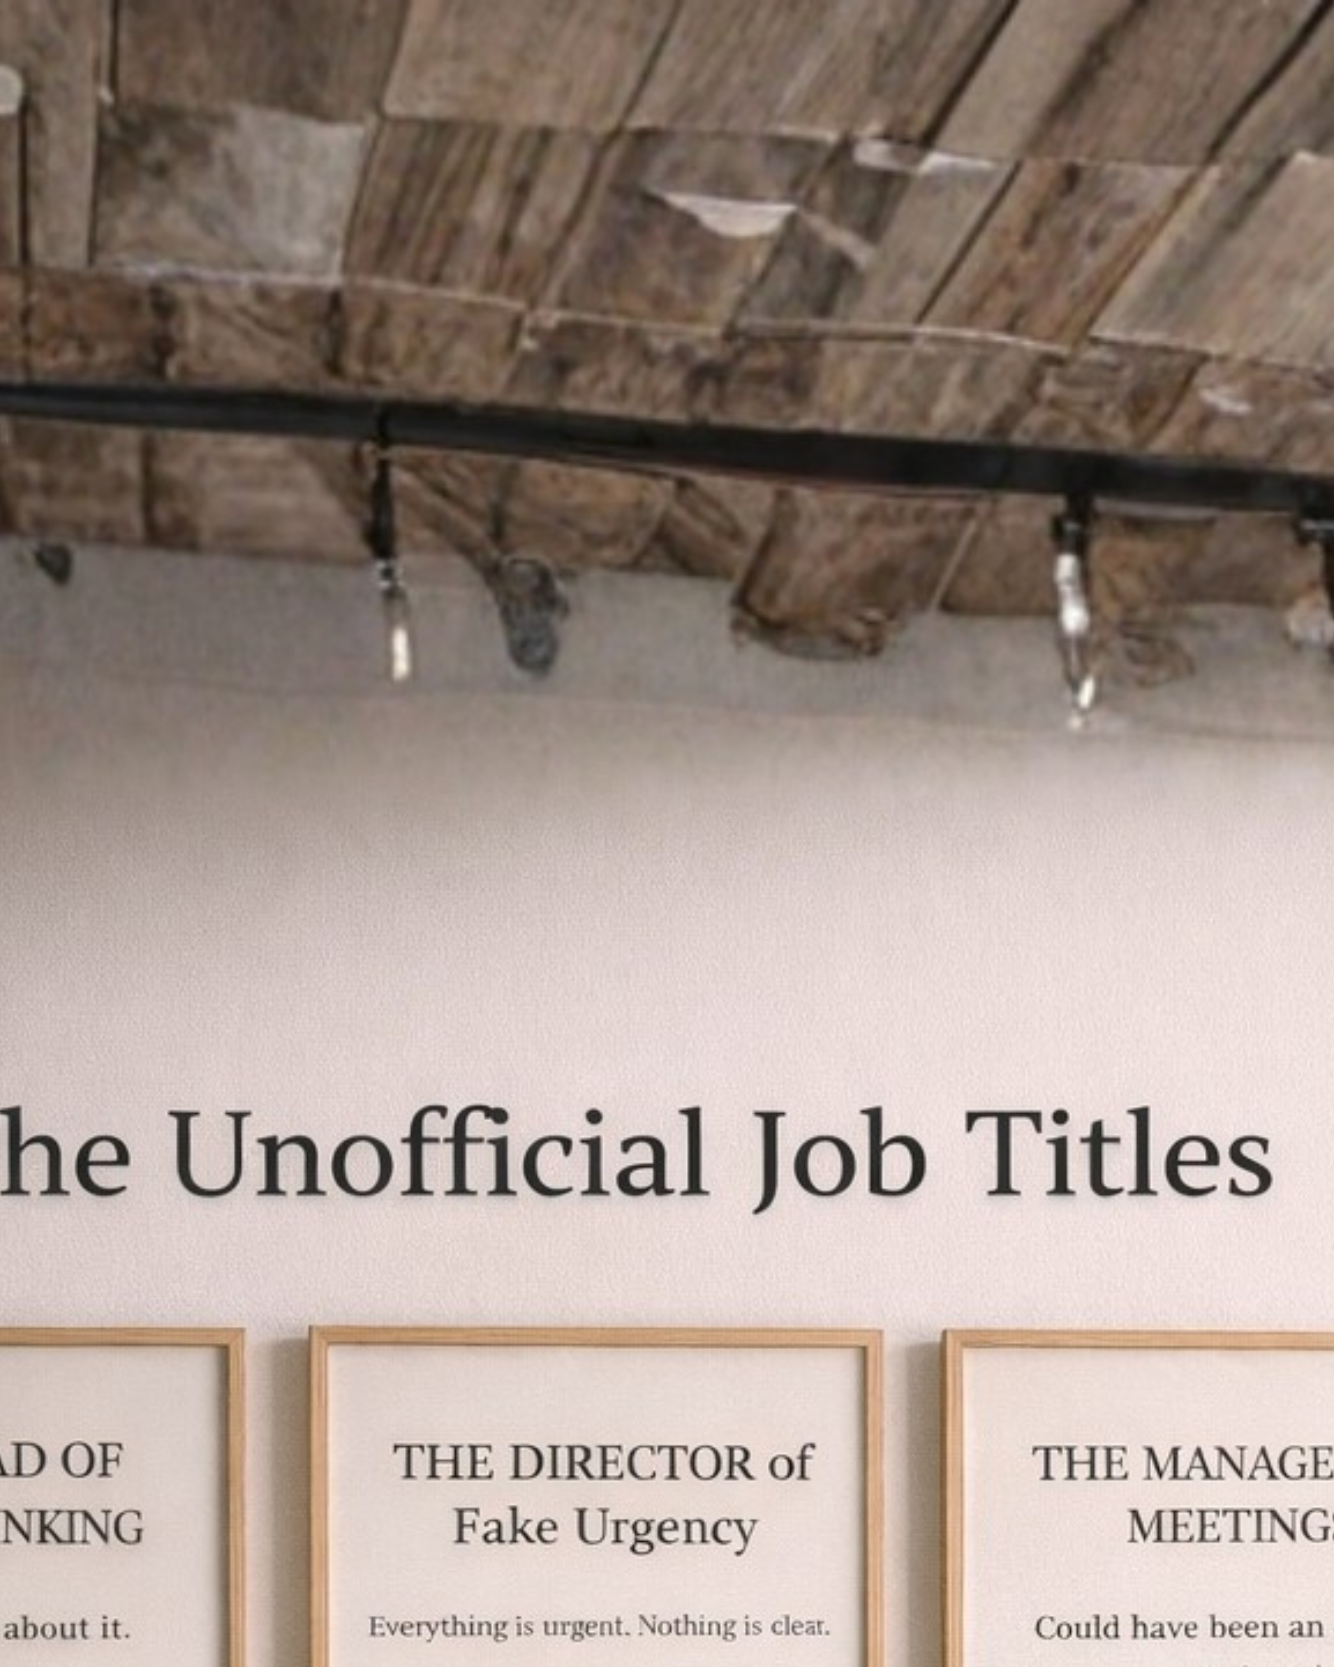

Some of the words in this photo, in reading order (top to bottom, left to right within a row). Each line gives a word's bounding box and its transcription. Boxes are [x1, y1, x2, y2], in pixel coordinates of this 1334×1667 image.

[167, 1104, 710, 1199] Unofficial
[752, 1106, 926, 1215] Job
[965, 1106, 1273, 1199] Titles
[61, 1441, 123, 1478] OF
[392, 1443, 494, 1480] THE
[509, 1443, 756, 1481] DIRECTOR
[768, 1442, 816, 1481] of
[1032, 1445, 1129, 1481] THE
[453, 1505, 558, 1545] Fake
[574, 1506, 759, 1557] Urgency
[4, 1615, 88, 1641] about
[101, 1615, 130, 1641] it.
[369, 1614, 509, 1643] Everything
[515, 1615, 534, 1637] is
[543, 1616, 631, 1643] urgent.
[639, 1614, 737, 1642] Nothing
[744, 1614, 763, 1636] is
[771, 1614, 830, 1636] clear.
[1034, 1614, 1120, 1640] Could
[1131, 1613, 1199, 1640] have
[1209, 1613, 1279, 1639] been
[1288, 1620, 1324, 1638] an
